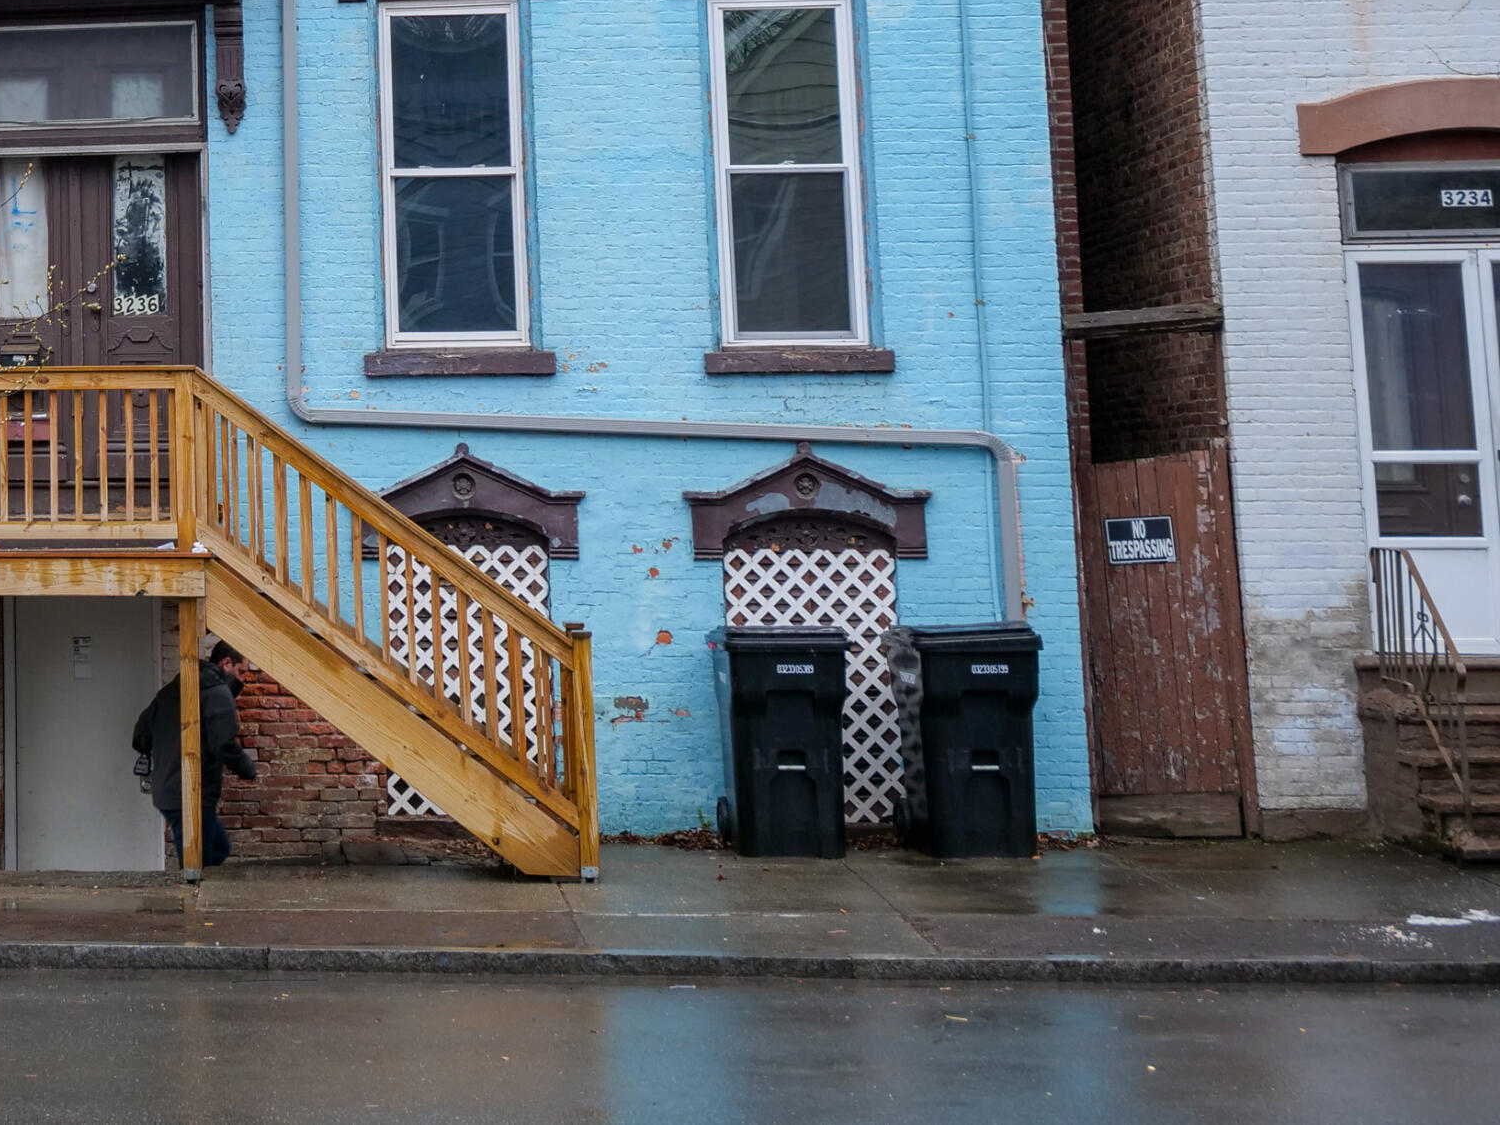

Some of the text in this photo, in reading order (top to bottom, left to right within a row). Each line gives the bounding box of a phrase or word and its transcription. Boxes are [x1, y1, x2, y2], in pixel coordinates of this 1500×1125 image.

[1443, 190, 1491, 206] 3234
[114, 296, 158, 312] 3236
[1131, 520, 1146, 539] NO
[1109, 538, 1174, 560] TRESPASSING
